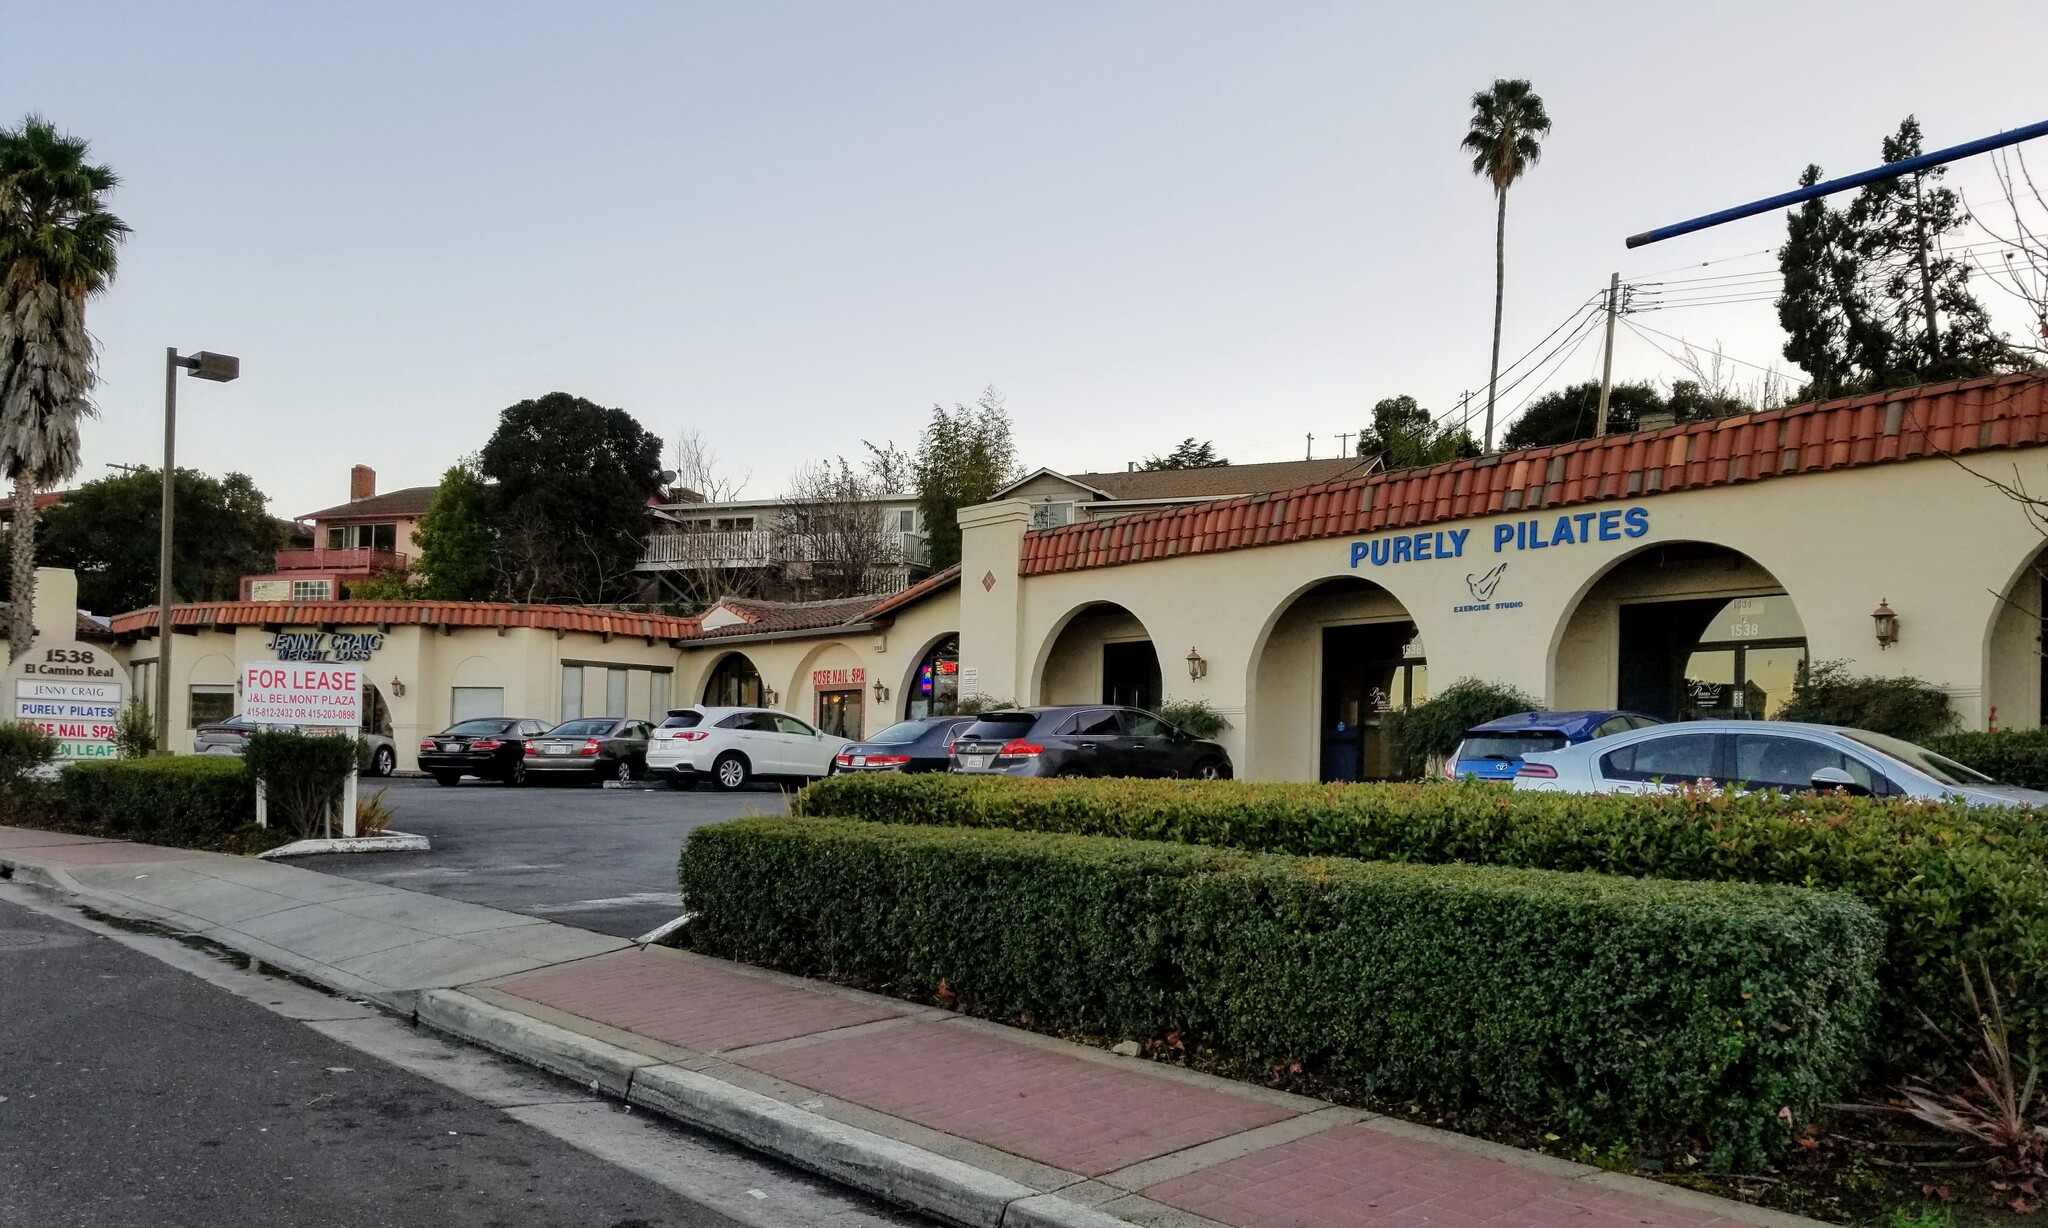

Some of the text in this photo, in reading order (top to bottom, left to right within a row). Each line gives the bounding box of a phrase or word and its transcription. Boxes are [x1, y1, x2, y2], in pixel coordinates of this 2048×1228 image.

[1350, 507, 1649, 568] PURELY PILATES
[1453, 601, 1524, 613] EXERCISE STUDIO
[1731, 623, 1759, 637] 1538
[266, 632, 384, 650] JENNY CRAIG
[277, 650, 372, 661] WEIGHT LOSS
[1402, 643, 1422, 655] 1538
[46, 649, 94, 663] 1538
[25, 663, 114, 677] El Camino Real
[813, 667, 865, 684] ROSE NAIL SPA
[248, 669, 356, 691] FOR LEASE
[34, 685, 104, 697] JENNY CRAIG
[247, 693, 356, 705] J&L BELMONT PLAZA
[22, 704, 114, 717] PURELY PILATES
[247, 707, 293, 718] 415-812-2432
[295, 708, 306, 718] OR
[59, 724, 87, 737] NAIL
[92, 725, 115, 738] SPA
[77, 744, 115, 756] LEAF
